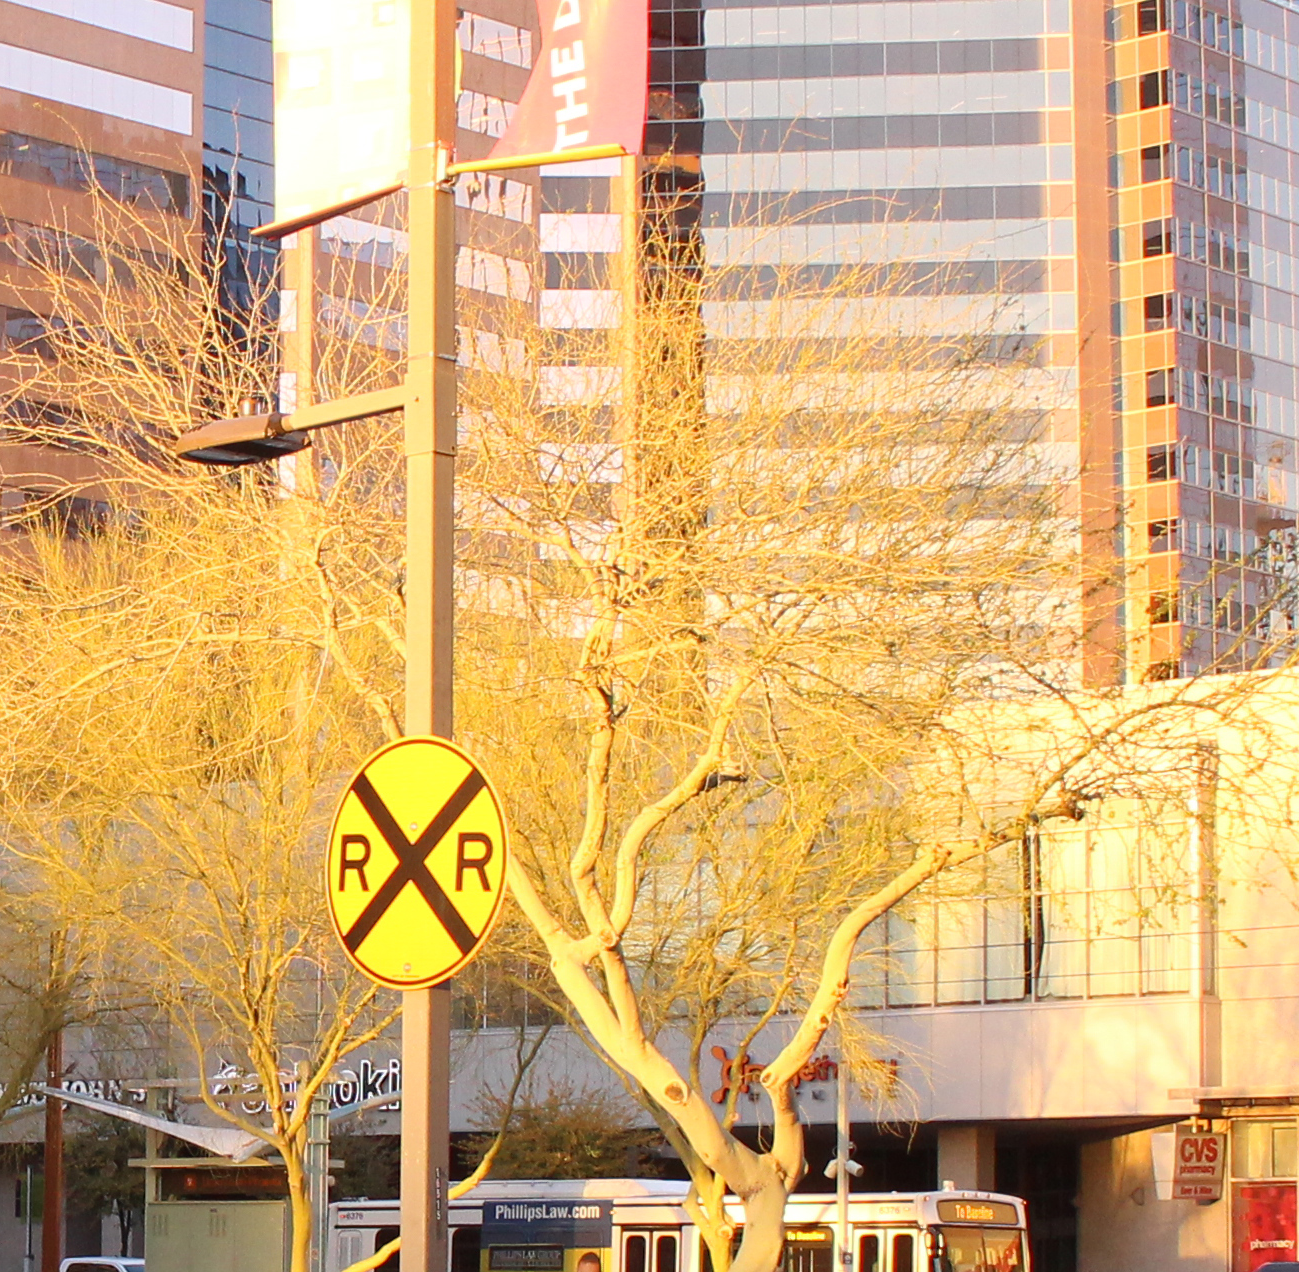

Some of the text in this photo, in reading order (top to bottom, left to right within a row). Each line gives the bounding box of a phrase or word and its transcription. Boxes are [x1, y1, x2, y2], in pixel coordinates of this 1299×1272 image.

[550, 39, 589, 152] THE
[338, 834, 371, 892] R
[455, 832, 493, 892] R
[1180, 1136, 1218, 1163] CVS
[1179, 1164, 1216, 1176] pharmacy
[494, 1203, 601, 1222] PhillipsLaw.com
[1250, 1239, 1295, 1251] pharmacy
